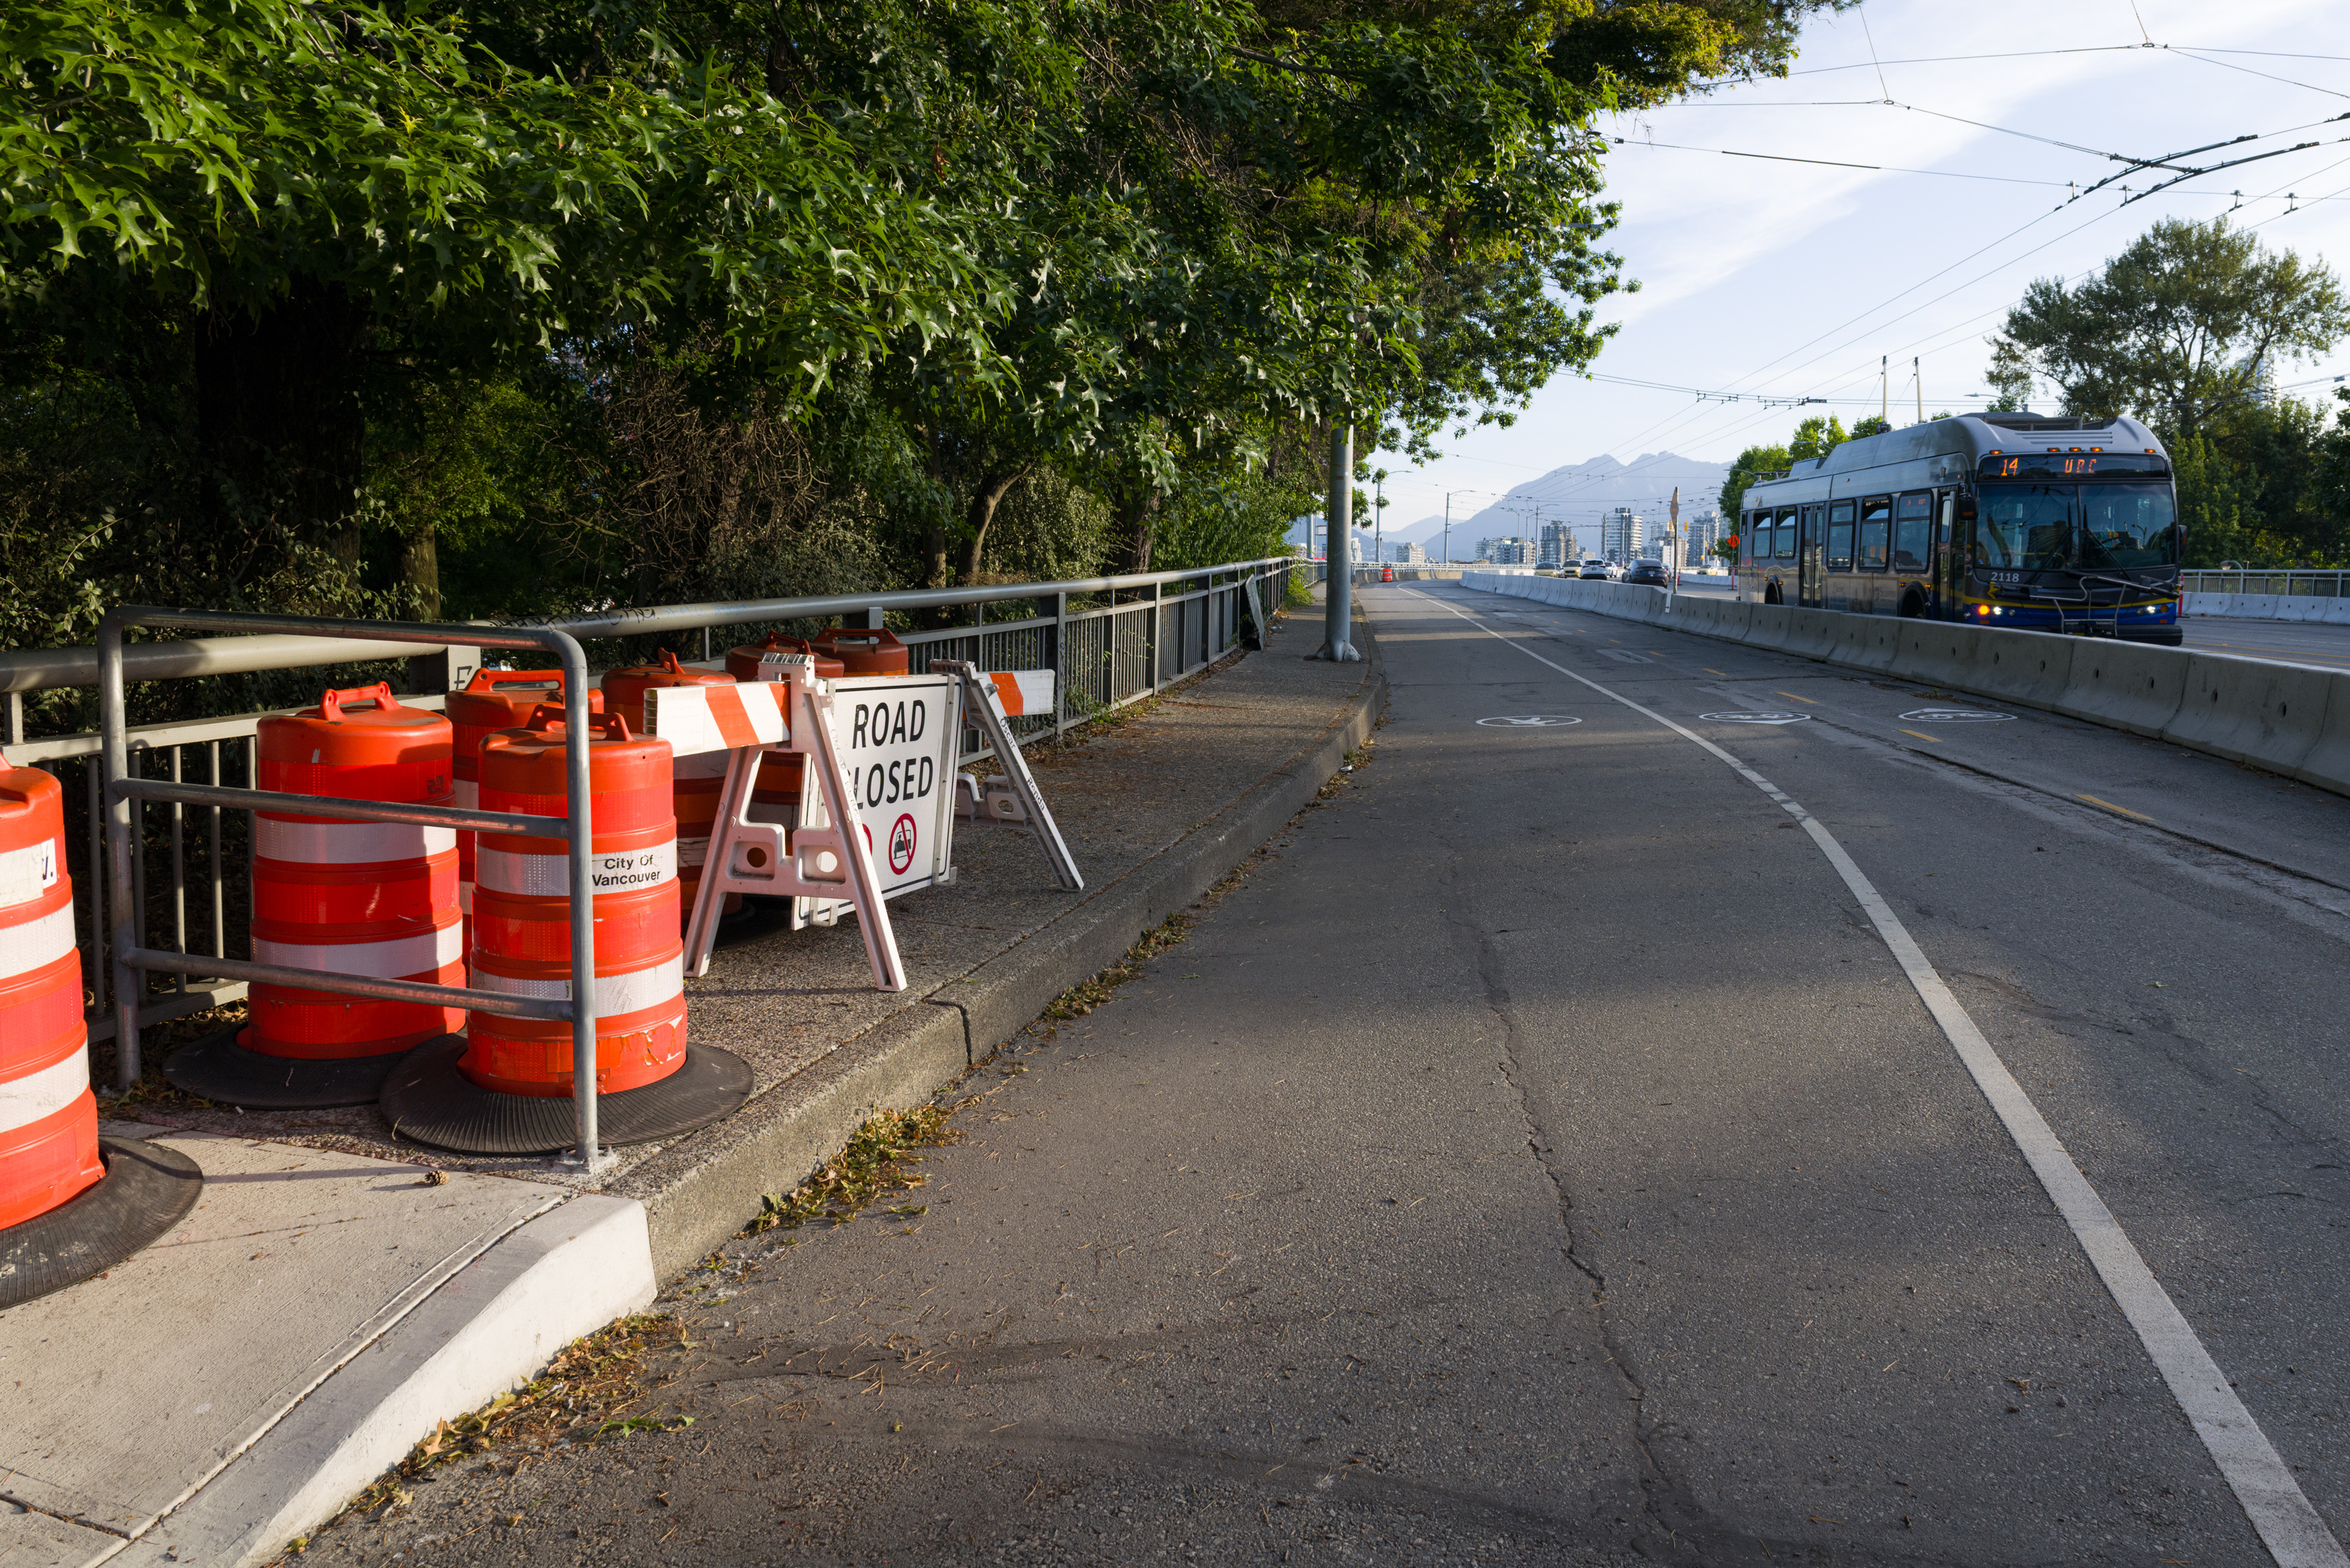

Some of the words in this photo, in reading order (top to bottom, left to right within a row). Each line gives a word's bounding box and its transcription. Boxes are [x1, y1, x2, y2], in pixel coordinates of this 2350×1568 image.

[2000, 458, 2018, 476] 14
[2065, 458, 2097, 474] UBC
[1990, 572, 2020, 582] 2118
[852, 699, 926, 749] ROAD
[999, 718, 1016, 748] Oscar
[1027, 777, 1045, 811] Renda
[847, 755, 933, 810] LOSED
[604, 858, 634, 870] City
[640, 854, 654, 867] Of
[592, 871, 661, 886] Vancouver
